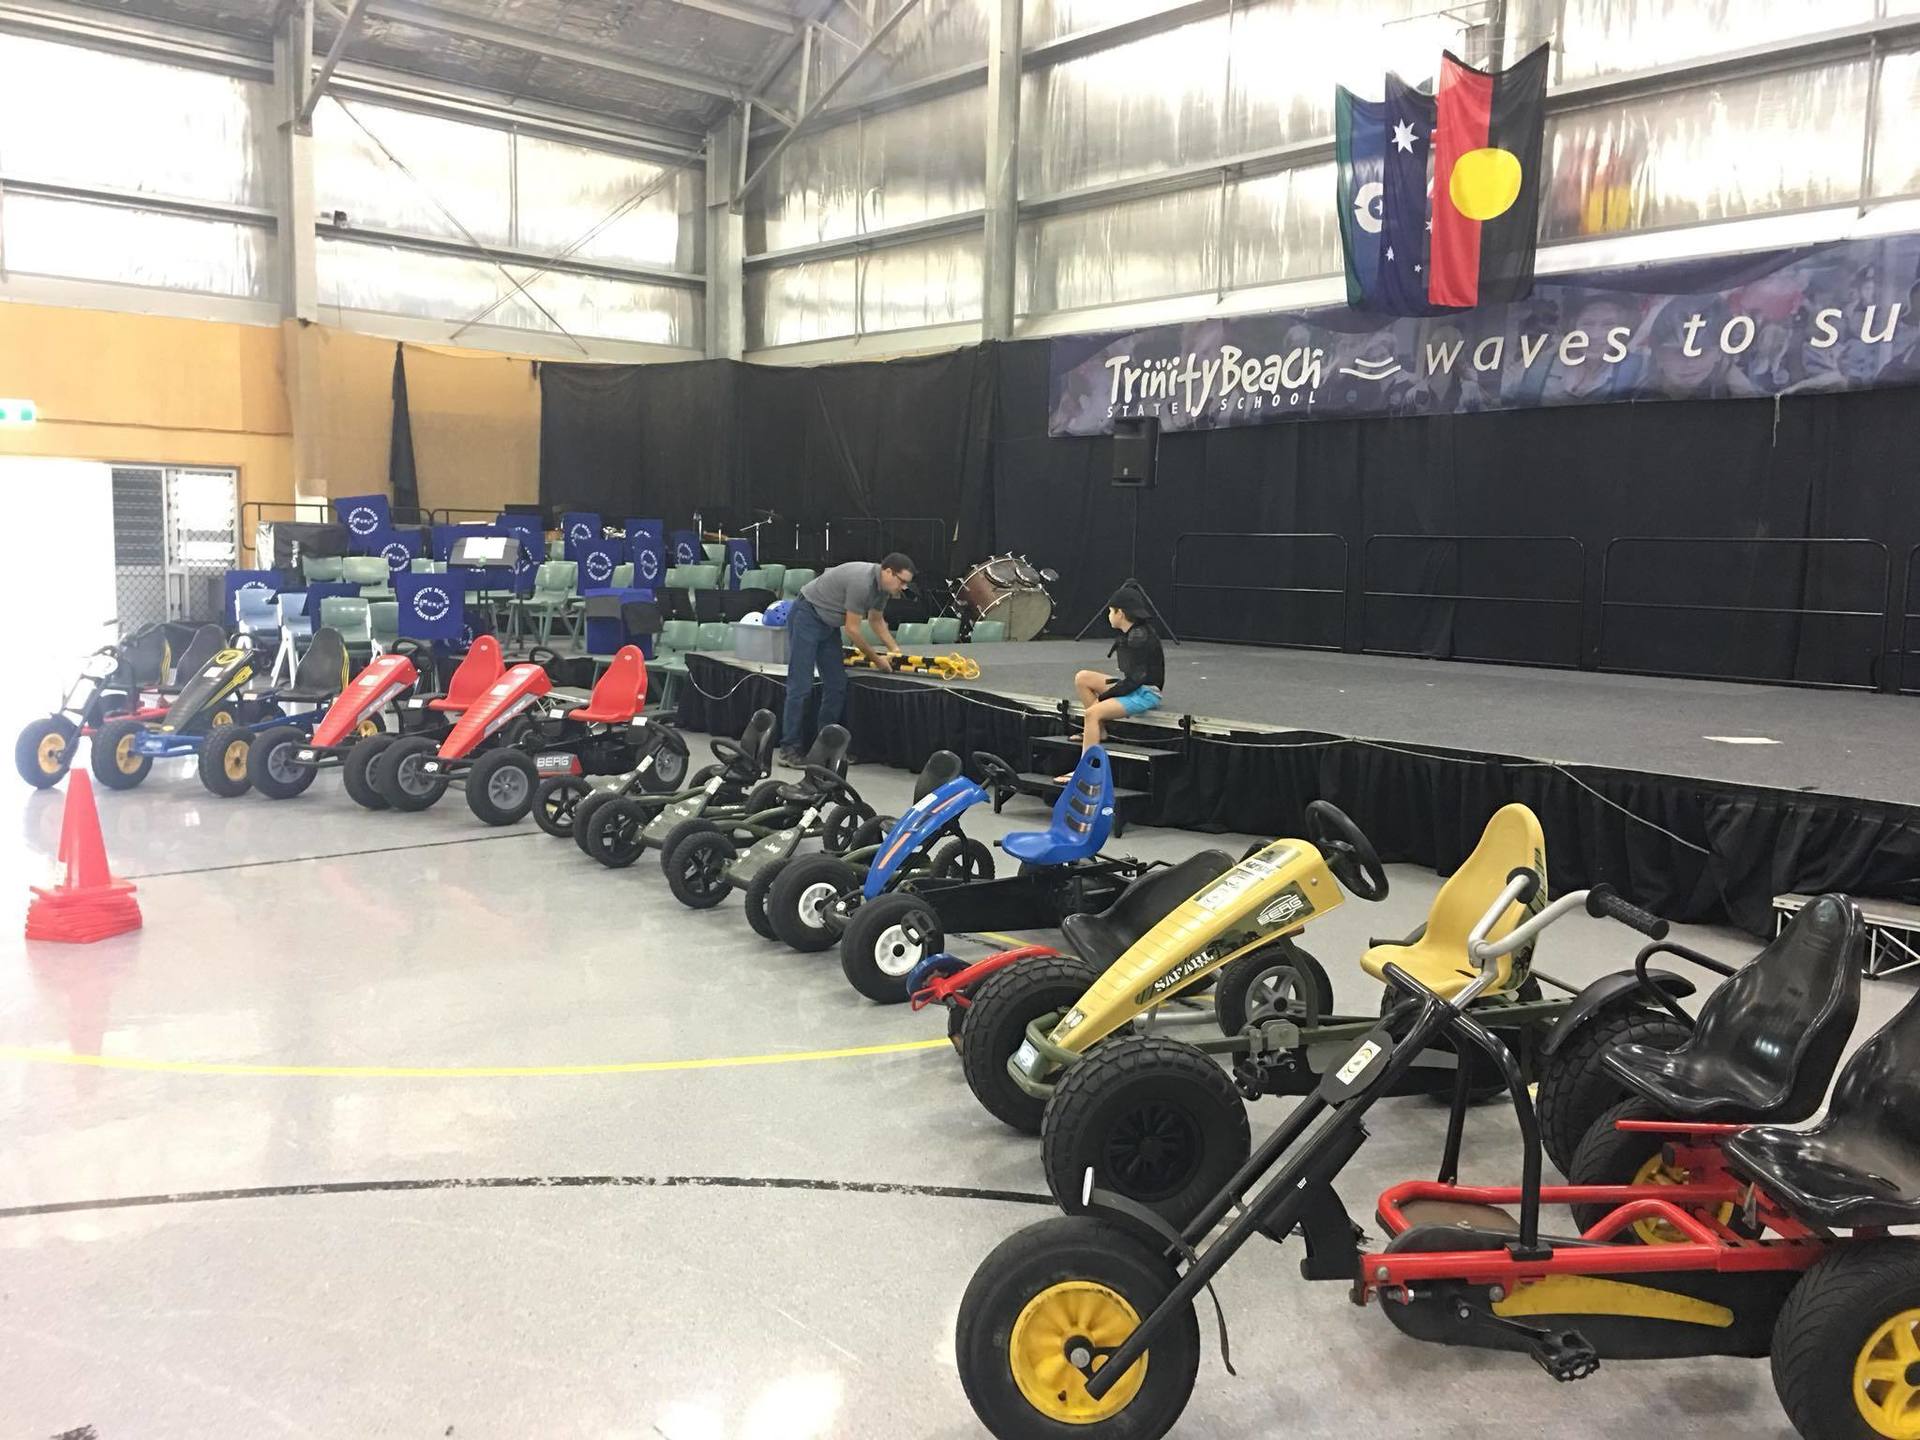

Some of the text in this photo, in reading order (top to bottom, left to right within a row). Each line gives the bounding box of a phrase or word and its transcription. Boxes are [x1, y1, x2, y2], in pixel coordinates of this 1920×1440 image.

[1425, 303, 1902, 376] waves to su
[1107, 390, 1316, 418] STATE SCHOOL
[536, 755, 569, 768] BERG
[1257, 894, 1304, 925] BERG
[1154, 951, 1214, 992] SAFARI
